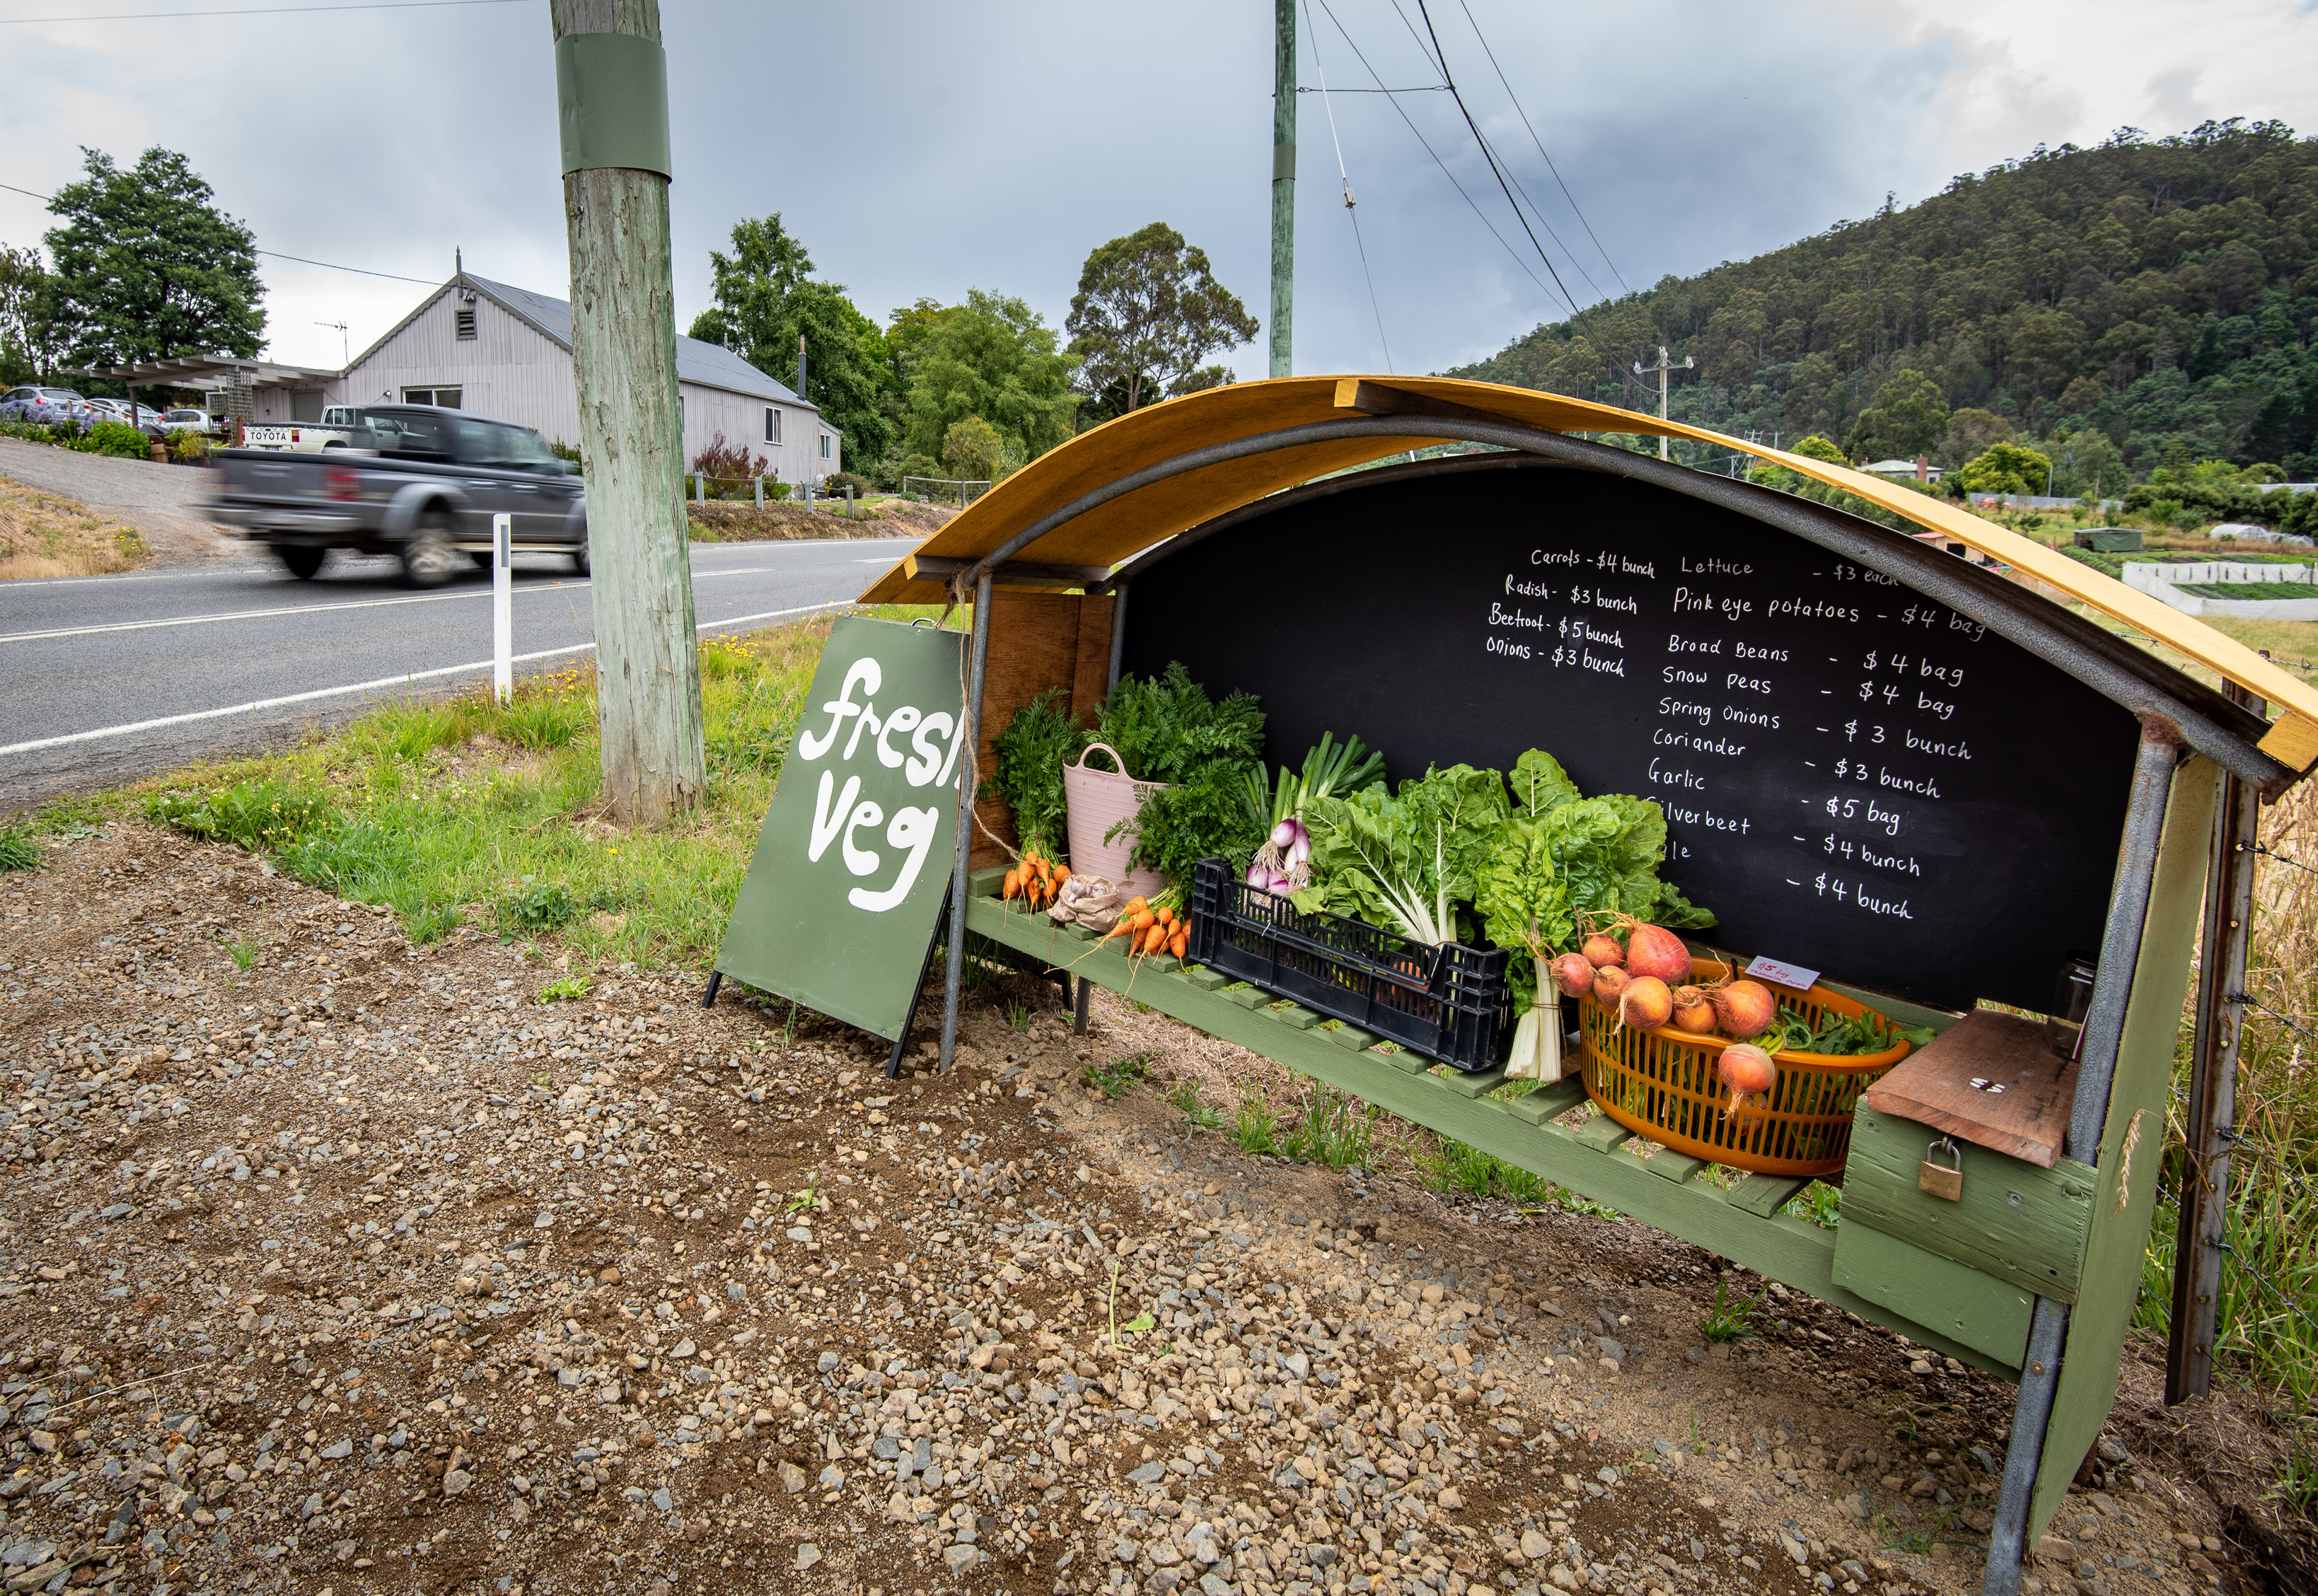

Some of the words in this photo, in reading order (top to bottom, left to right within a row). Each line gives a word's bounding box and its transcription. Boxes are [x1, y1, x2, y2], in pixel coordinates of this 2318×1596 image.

[250, 432, 286, 441] TOYOTA
[1532, 549, 1579, 566] Carrots
[1597, 551, 1616, 573] $4
[1623, 557, 1655, 578] bunch
[1682, 557, 1753, 574] Lettuce
[1833, 564, 1855, 580] $3
[1571, 586, 1590, 603] $3
[1597, 588, 1636, 614] bunch
[1674, 587, 1713, 612] Pink
[1722, 599, 1751, 620] eye
[1769, 598, 1858, 622] potatoes
[1902, 605, 1935, 627] $4
[1949, 612, 1986, 642] bag
[1559, 617, 1584, 638] $5
[1586, 625, 1623, 648] bunch
[1552, 646, 1576, 667] $3
[1583, 648, 1624, 677] bunch
[1668, 635, 1721, 653] Broad
[1736, 642, 1788, 661] Beans
[1921, 658, 1963, 687] bag
[1663, 667, 1707, 682] Snow
[1918, 692, 1954, 719] bag
[1659, 697, 1710, 726] Spring
[1906, 730, 1971, 759] bunch
[1654, 728, 1745, 759] Coriander
[1835, 758, 1867, 780] $3
[1881, 767, 1940, 798] bunch
[1649, 757, 1705, 789] Garlic
[1826, 796, 1860, 817] $5
[1868, 800, 1899, 835] bag
[808, 769, 939, 912] Veg
[1824, 834, 1853, 859] $4
[1862, 847, 1919, 876] bunch
[1815, 873, 1847, 901] $4
[1858, 883, 1913, 919] bunch
[1757, 962, 1778, 972] $5
[1775, 969, 1790, 979] bag
